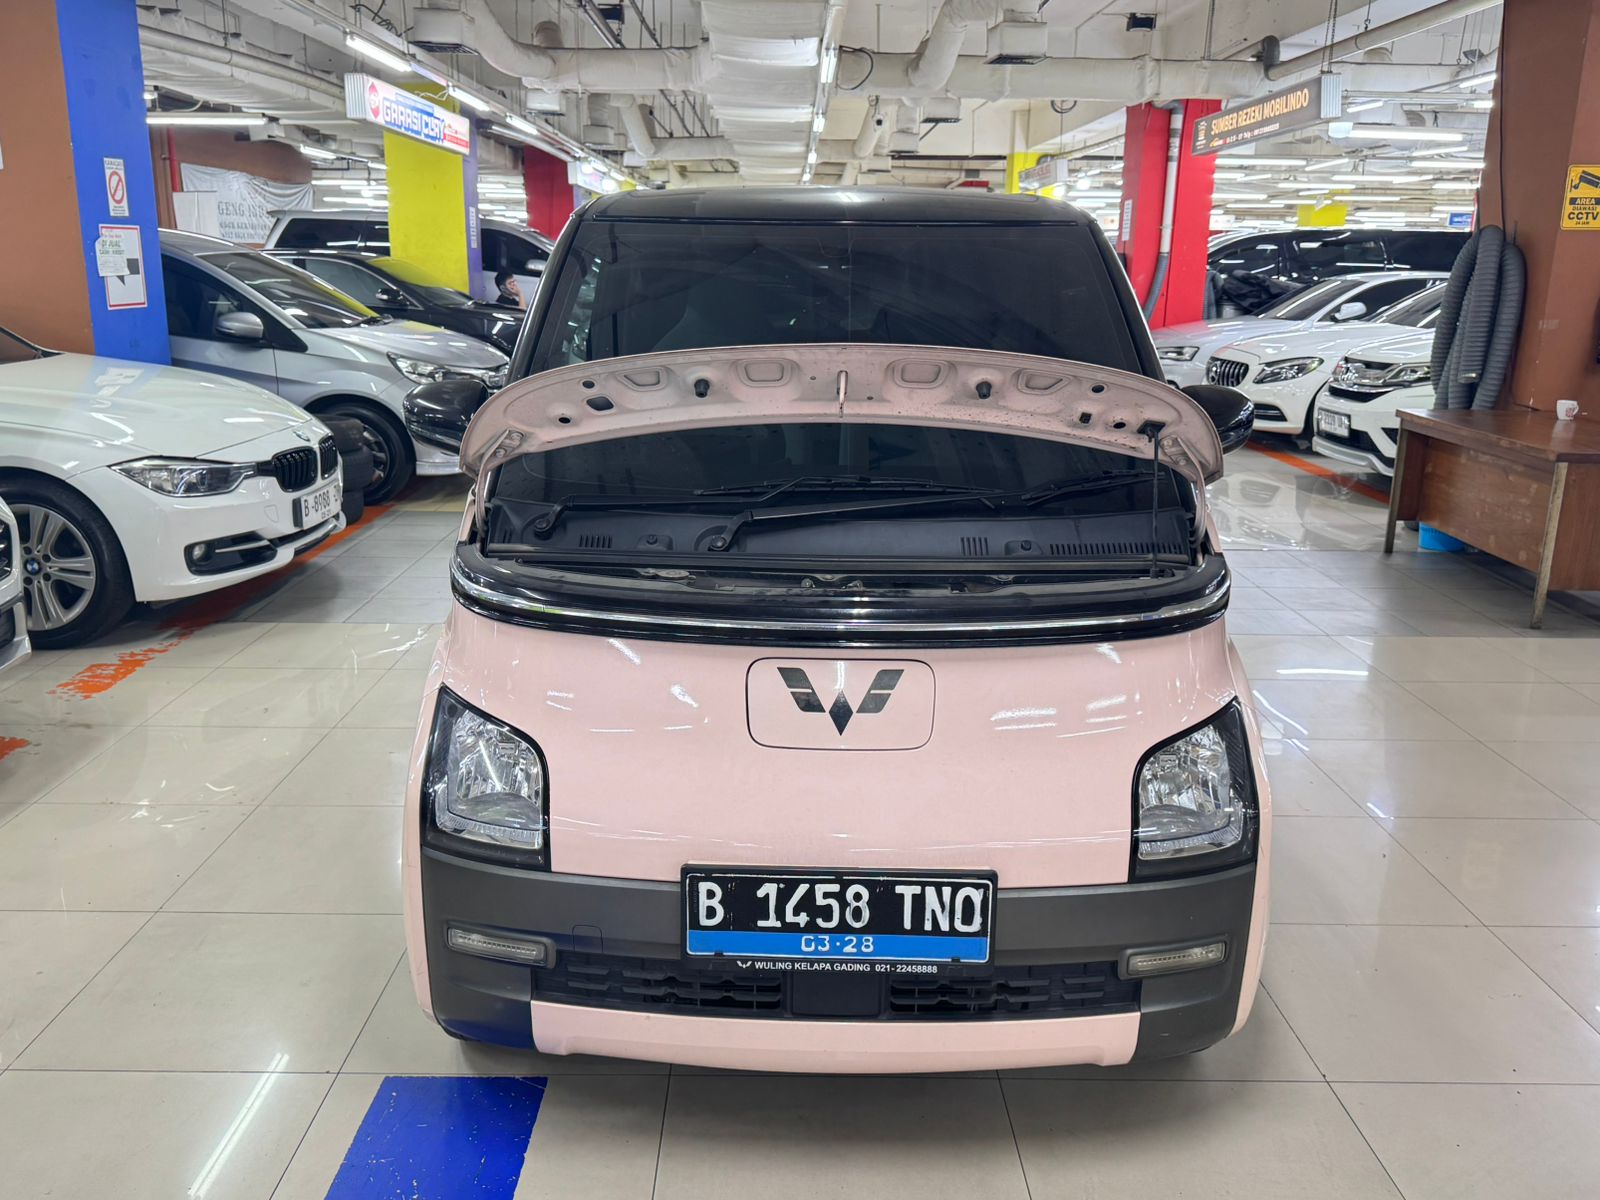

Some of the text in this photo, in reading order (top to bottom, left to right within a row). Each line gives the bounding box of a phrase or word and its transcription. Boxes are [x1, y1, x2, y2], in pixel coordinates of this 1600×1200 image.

[384, 100, 422, 132] GARASI
[1211, 112, 1238, 135] SUMBER
[1238, 103, 1263, 127] REZEKI
[1263, 88, 1309, 119] MOBILINDO
[218, 201, 245, 217] GENG
[1568, 212, 1599, 221] CCTV
[304, 499, 310, 517] B
[699, 881, 725, 927] B
[756, 882, 870, 928] 1458
[755, 961, 792, 970] WULING
[794, 962, 831, 971] KELAPA
[833, 963, 871, 972] GADING
